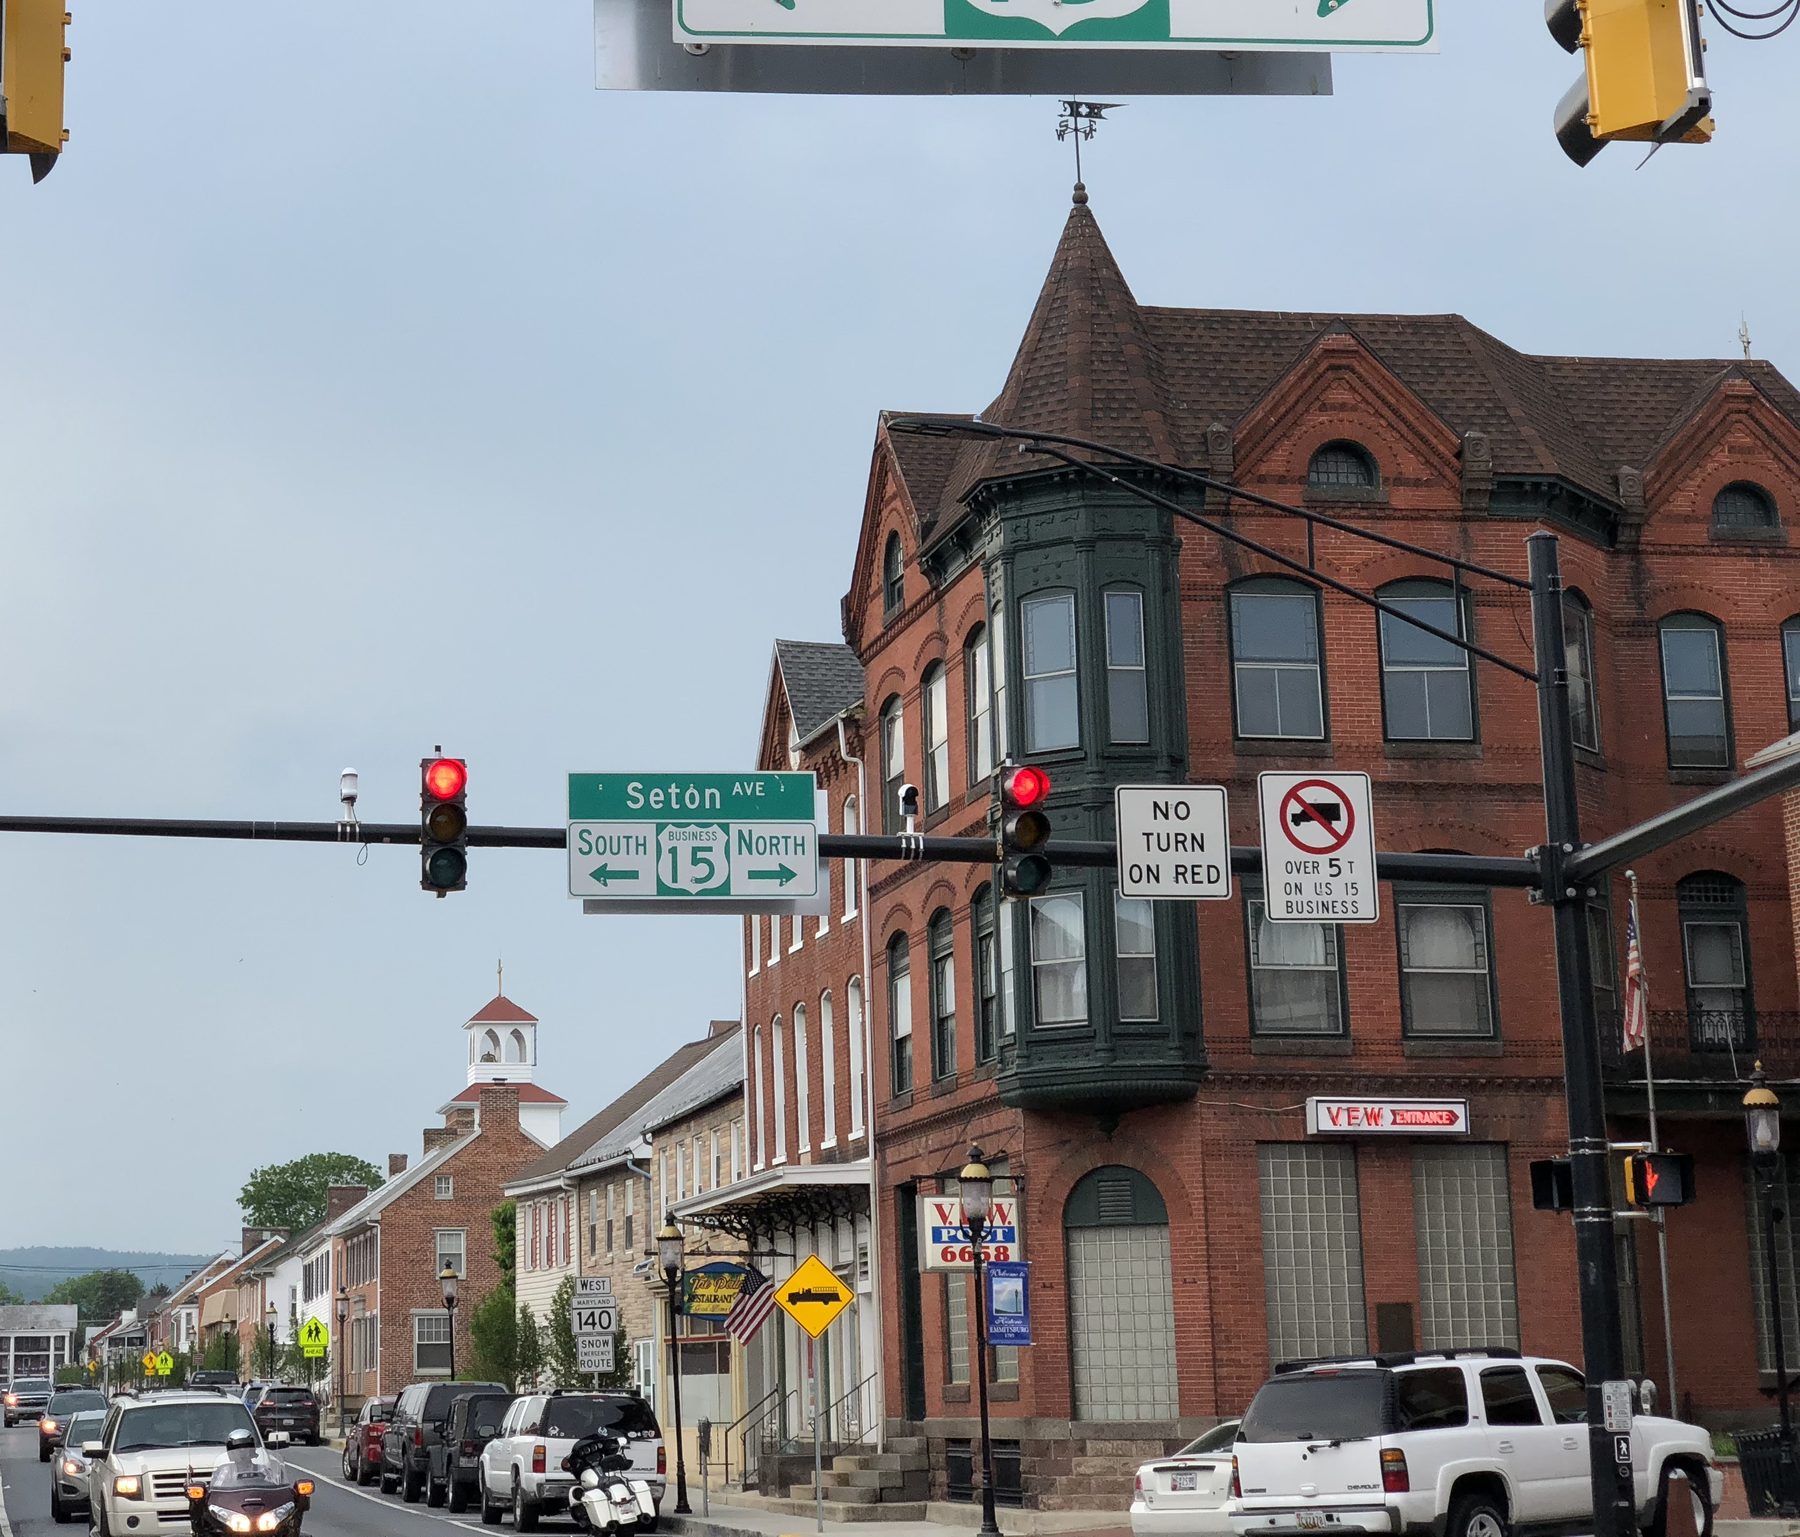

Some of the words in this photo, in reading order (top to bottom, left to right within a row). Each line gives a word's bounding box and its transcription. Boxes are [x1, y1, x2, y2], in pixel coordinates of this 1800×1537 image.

[626, 782, 721, 809] Seton
[732, 782, 766, 796] AVE
[1152, 801, 1191, 821] NO
[578, 828, 648, 856] SOUTH
[668, 830, 718, 842] BUSINESS
[737, 829, 806, 856] NORTH
[1142, 832, 1206, 852] TURN
[667, 846, 716, 884] 15
[1285, 860, 1320, 875] OVER
[1328, 858, 1342, 877] 5
[1347, 861, 1355, 874] T
[1129, 864, 1161, 884] ON
[1174, 864, 1221, 885] RED
[1284, 882, 1303, 896] ON
[1314, 882, 1333, 896] US
[1344, 882, 1359, 896] 15
[1285, 900, 1360, 915] BUSINESS
[1395, 1110, 1451, 1125] ENTRANCE
[580, 1279, 607, 1291] WEST
[690, 1276, 712, 1292] The
[576, 1298, 611, 1306] MARYLAND
[687, 1293, 733, 1304] RESTAURANT
[576, 1310, 612, 1331] 140
[581, 1339, 610, 1349] SNOW
[580, 1350, 611, 1358] EMERGENCY
[580, 1358, 612, 1369] ROUTE
